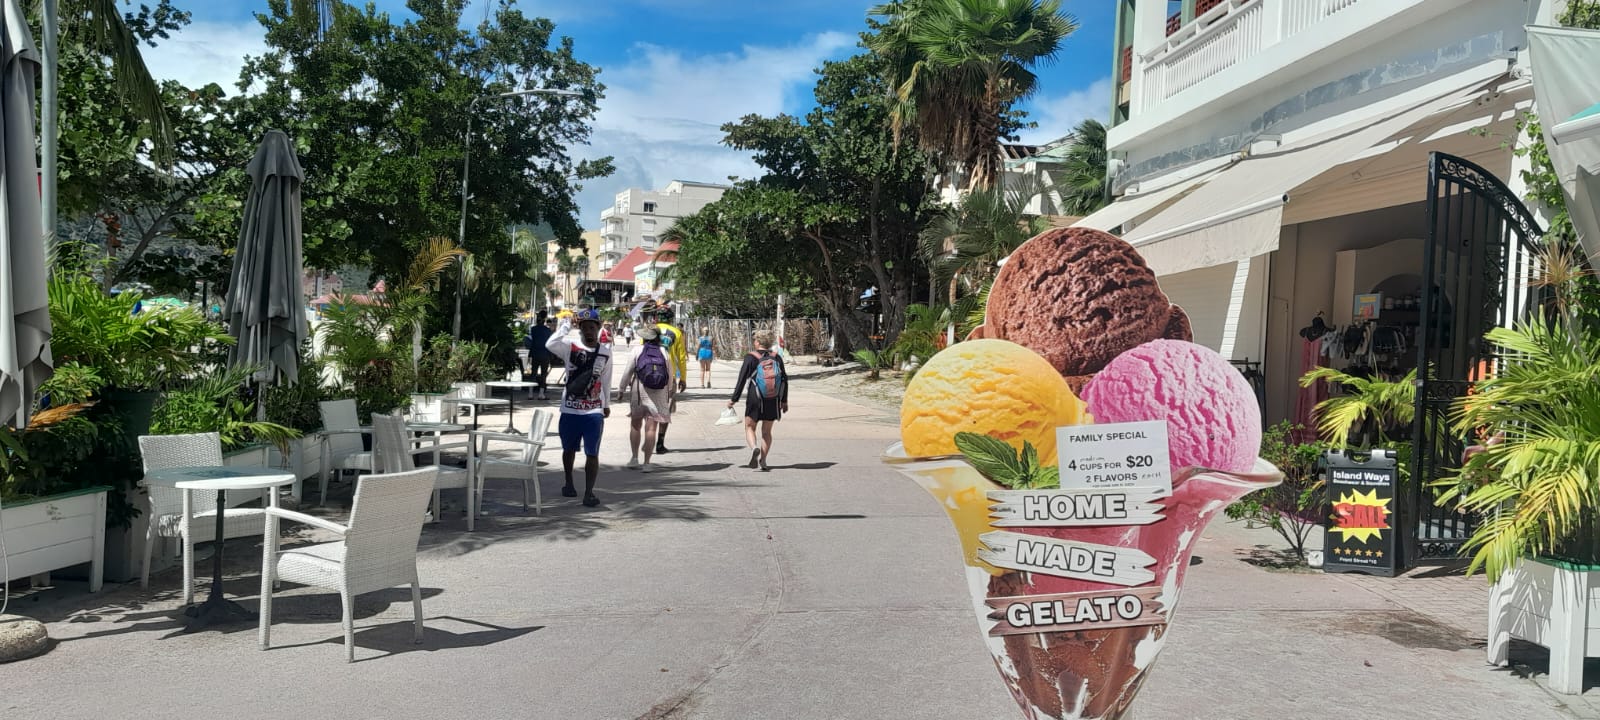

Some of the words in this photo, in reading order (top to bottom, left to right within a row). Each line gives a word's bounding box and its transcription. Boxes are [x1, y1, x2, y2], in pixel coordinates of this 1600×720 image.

[1069, 433, 1103, 443] FAMILY
[1106, 431, 1148, 440] SPECIAL
[1068, 459, 1077, 471] 4
[1080, 463, 1102, 471] CUPS
[1104, 461, 1121, 470] FOR
[1126, 455, 1153, 468] $20
[1085, 475, 1092, 483] 2
[1093, 472, 1138, 482] FLAVORS
[1333, 470, 1362, 480] Island
[1363, 472, 1390, 482] Ways
[1023, 493, 1127, 521] HOME
[1333, 502, 1388, 529] SALE
[1016, 539, 1116, 577] MADE
[1006, 594, 1143, 628] GELATO
